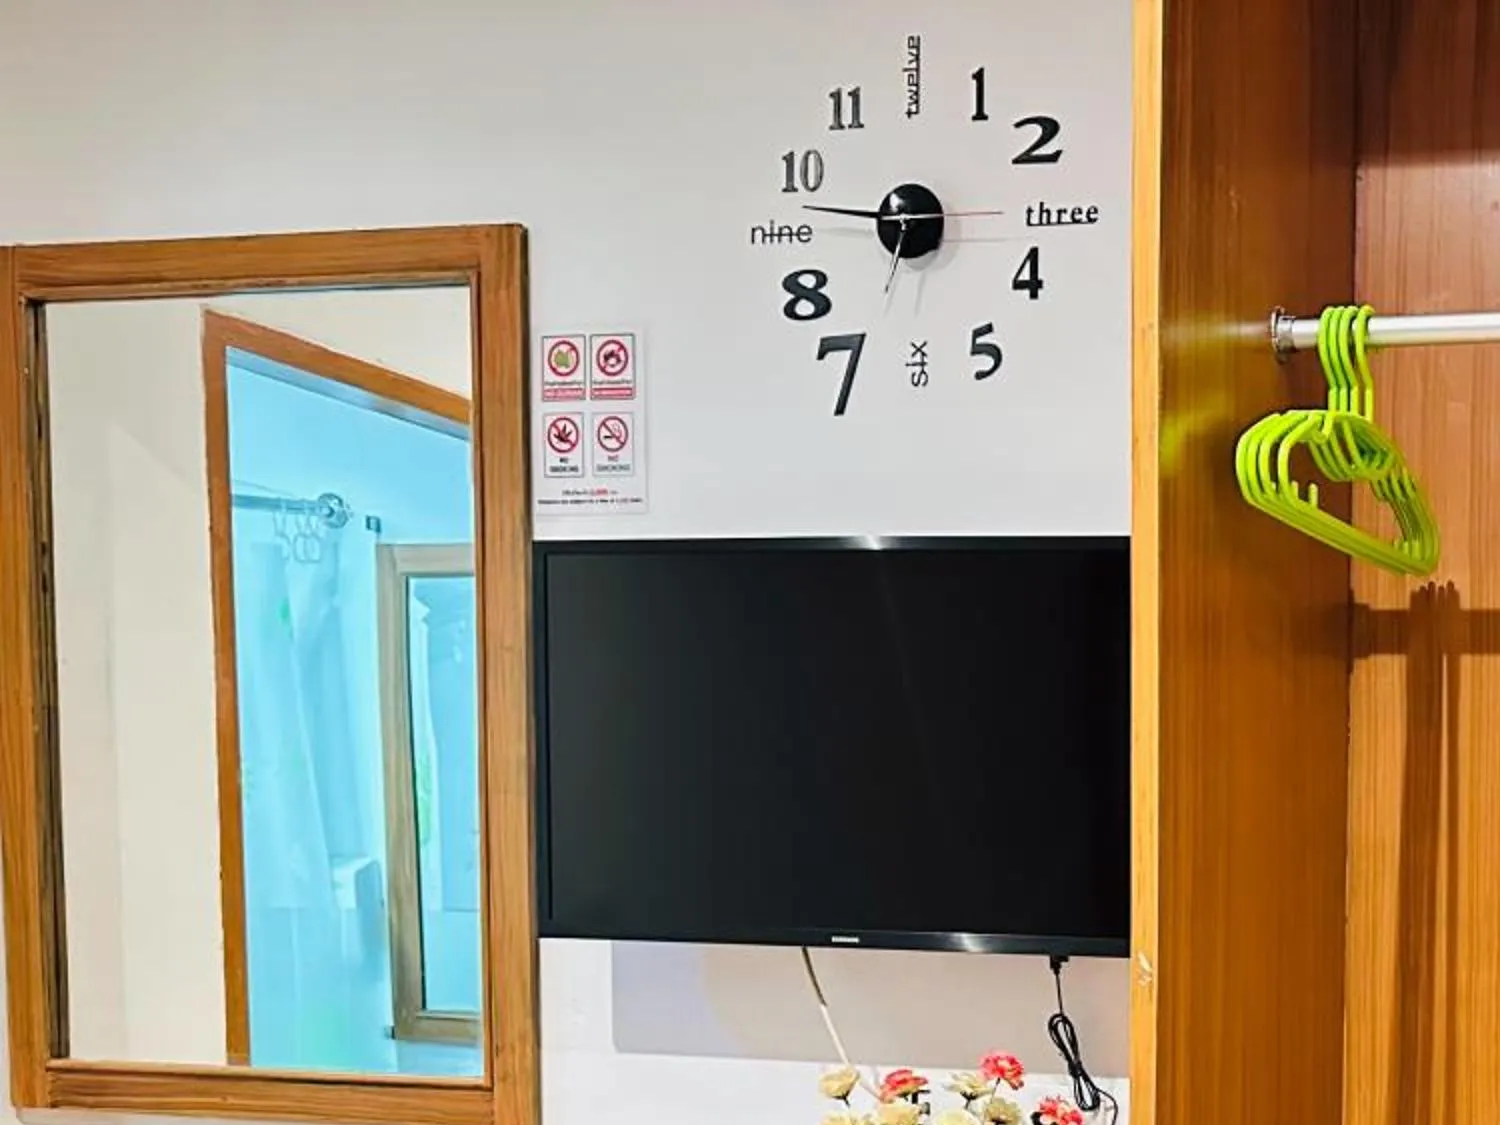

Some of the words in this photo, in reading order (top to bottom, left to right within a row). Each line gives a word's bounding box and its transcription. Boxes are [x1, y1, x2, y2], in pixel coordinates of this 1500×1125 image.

[903, 35, 921, 119] twelve
[970, 67, 989, 121] 1
[828, 86, 865, 131] 11
[1011, 116, 1063, 165] 2
[781, 149, 825, 193] 10
[750, 220, 813, 245] nine
[1025, 202, 1099, 227] three
[781, 269, 833, 321] 8
[1012, 246, 1044, 300] 4
[816, 332, 867, 417] 7
[905, 340, 928, 387] six
[970, 322, 1003, 381] 5
